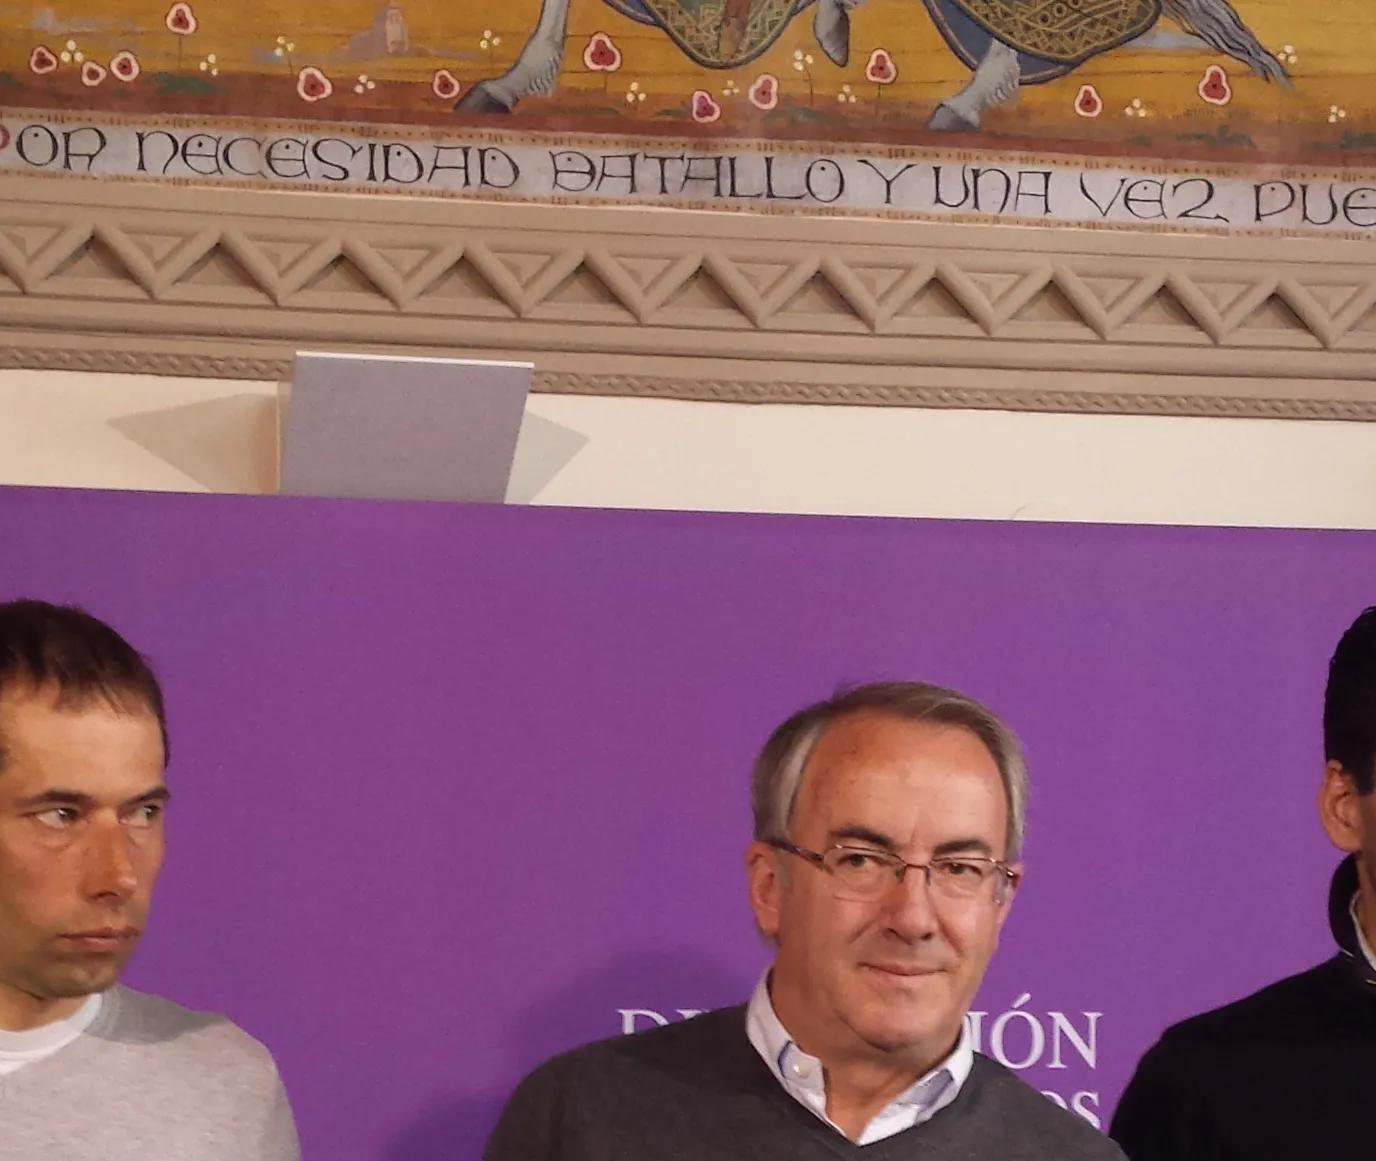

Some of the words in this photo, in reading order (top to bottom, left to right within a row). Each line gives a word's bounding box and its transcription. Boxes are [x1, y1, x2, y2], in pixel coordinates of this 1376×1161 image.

[549, 149, 845, 203] BATALLO
[858, 159, 916, 204] Y
[932, 163, 1052, 214] UNA
[1078, 176, 1229, 223] VEZ
